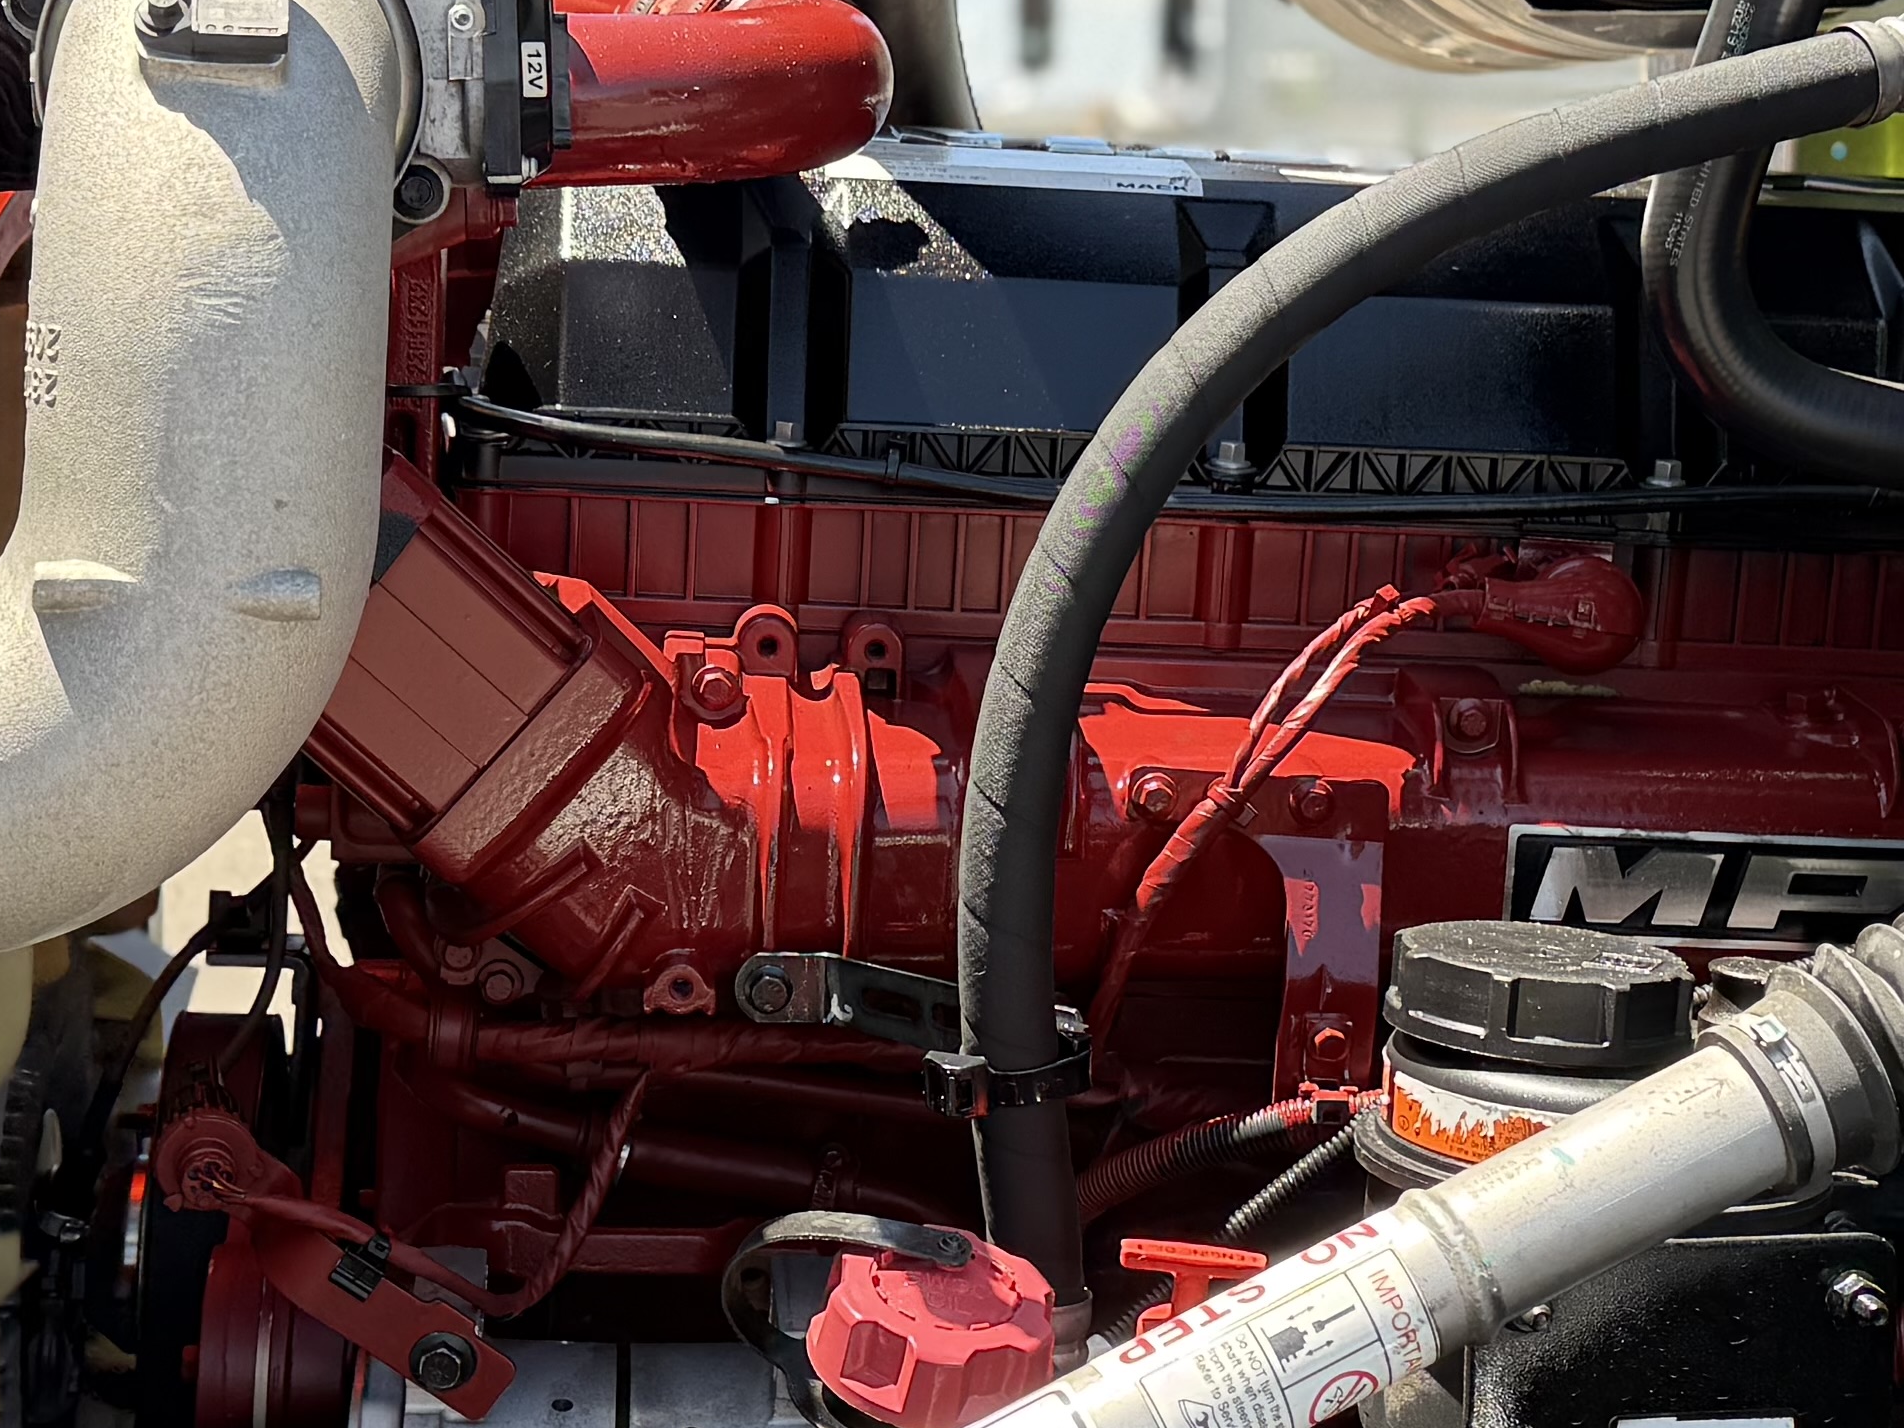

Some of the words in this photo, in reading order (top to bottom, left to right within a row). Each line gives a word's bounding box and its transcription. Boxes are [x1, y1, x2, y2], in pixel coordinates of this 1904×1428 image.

[526, 49, 544, 91] 12V
[1300, 1222, 1379, 1265] NO
[1119, 1282, 1266, 1365] STEP
[1244, 1349, 1268, 1380] NOT
[1209, 1386, 1224, 1401] to
[1220, 1374, 1238, 1395] the
[1234, 1368, 1260, 1402] when
